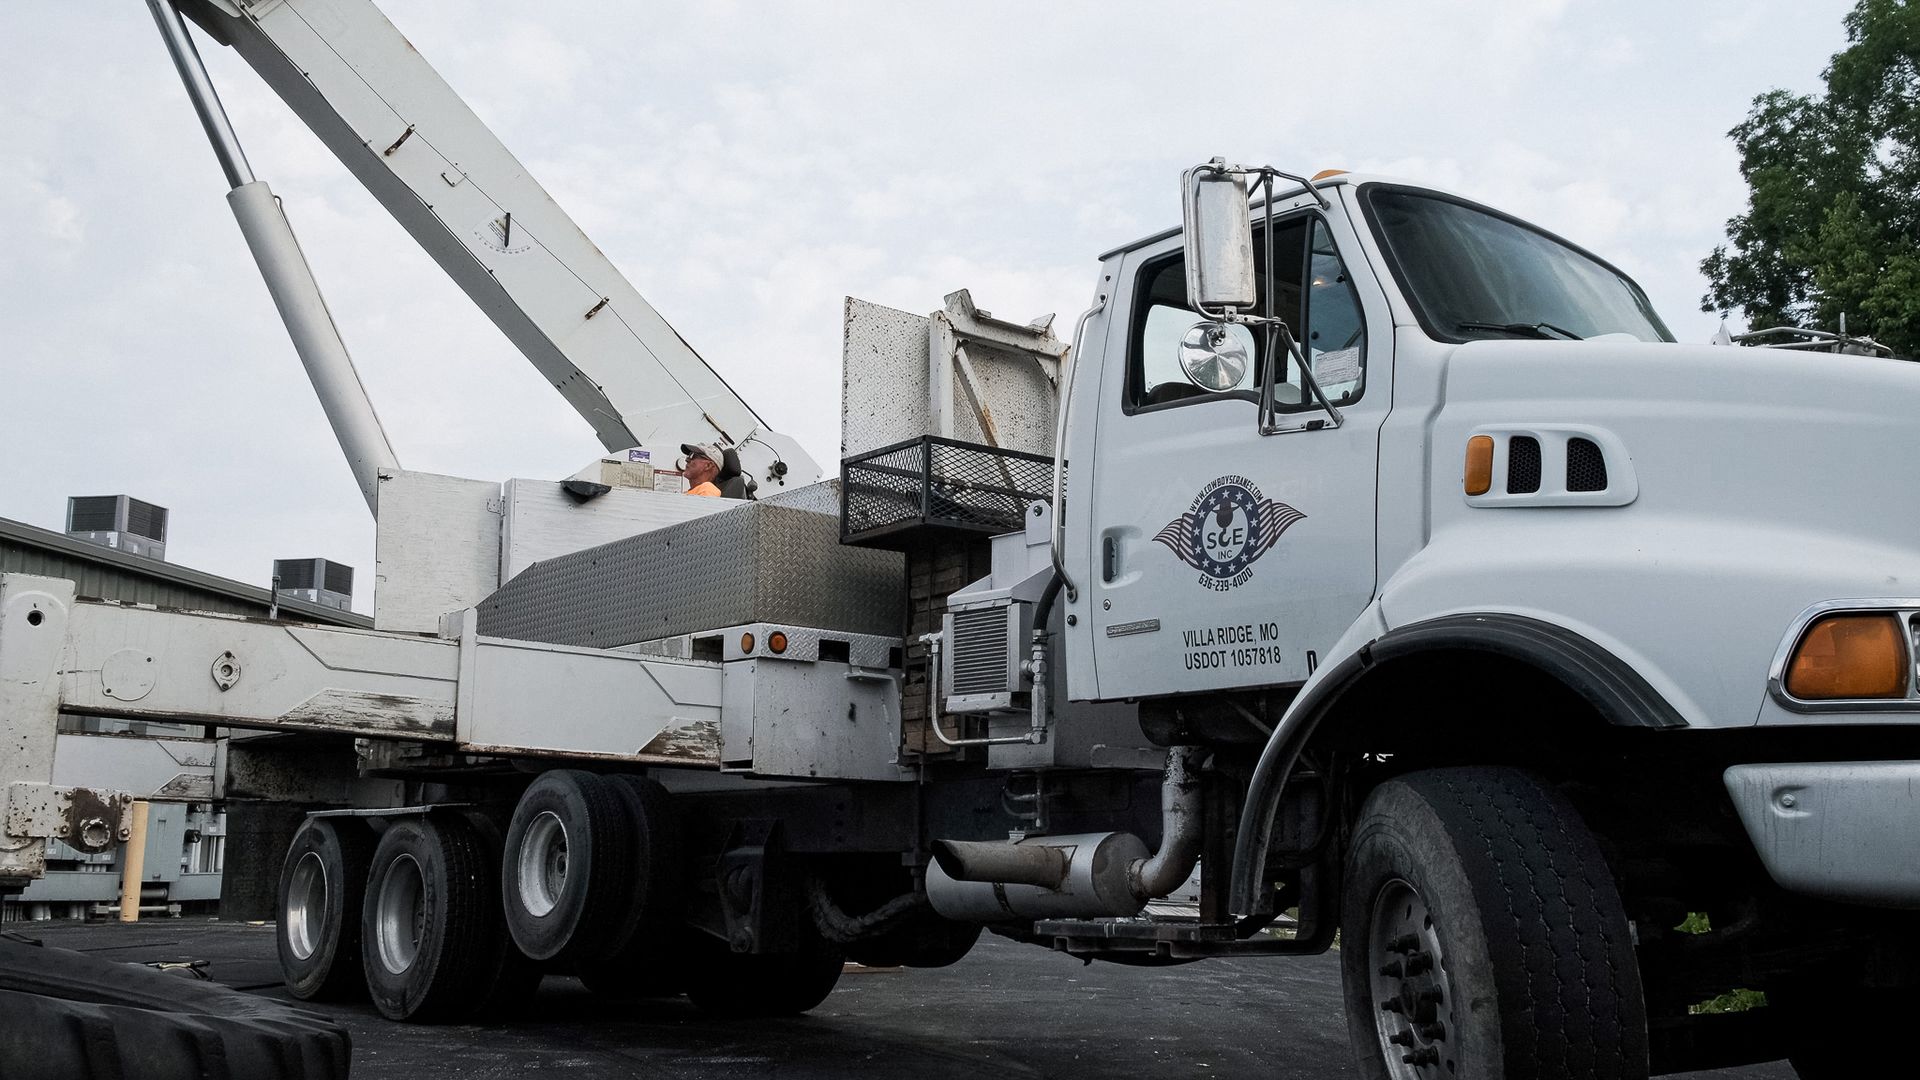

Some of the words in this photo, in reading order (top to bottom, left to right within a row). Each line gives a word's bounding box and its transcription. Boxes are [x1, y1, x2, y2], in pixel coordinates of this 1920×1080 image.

[1189, 474, 1264, 512] WWW.COWBOYSCRANES.COM
[1217, 549, 1233, 560] INC
[1198, 566, 1254, 592] 636-239-4000
[1182, 628, 1215, 648] VILLA
[1217, 624, 1257, 645] RIDGE,
[1259, 622, 1279, 641] MO
[1184, 650, 1227, 670] USDOT
[1230, 645, 1281, 667] 1057818
